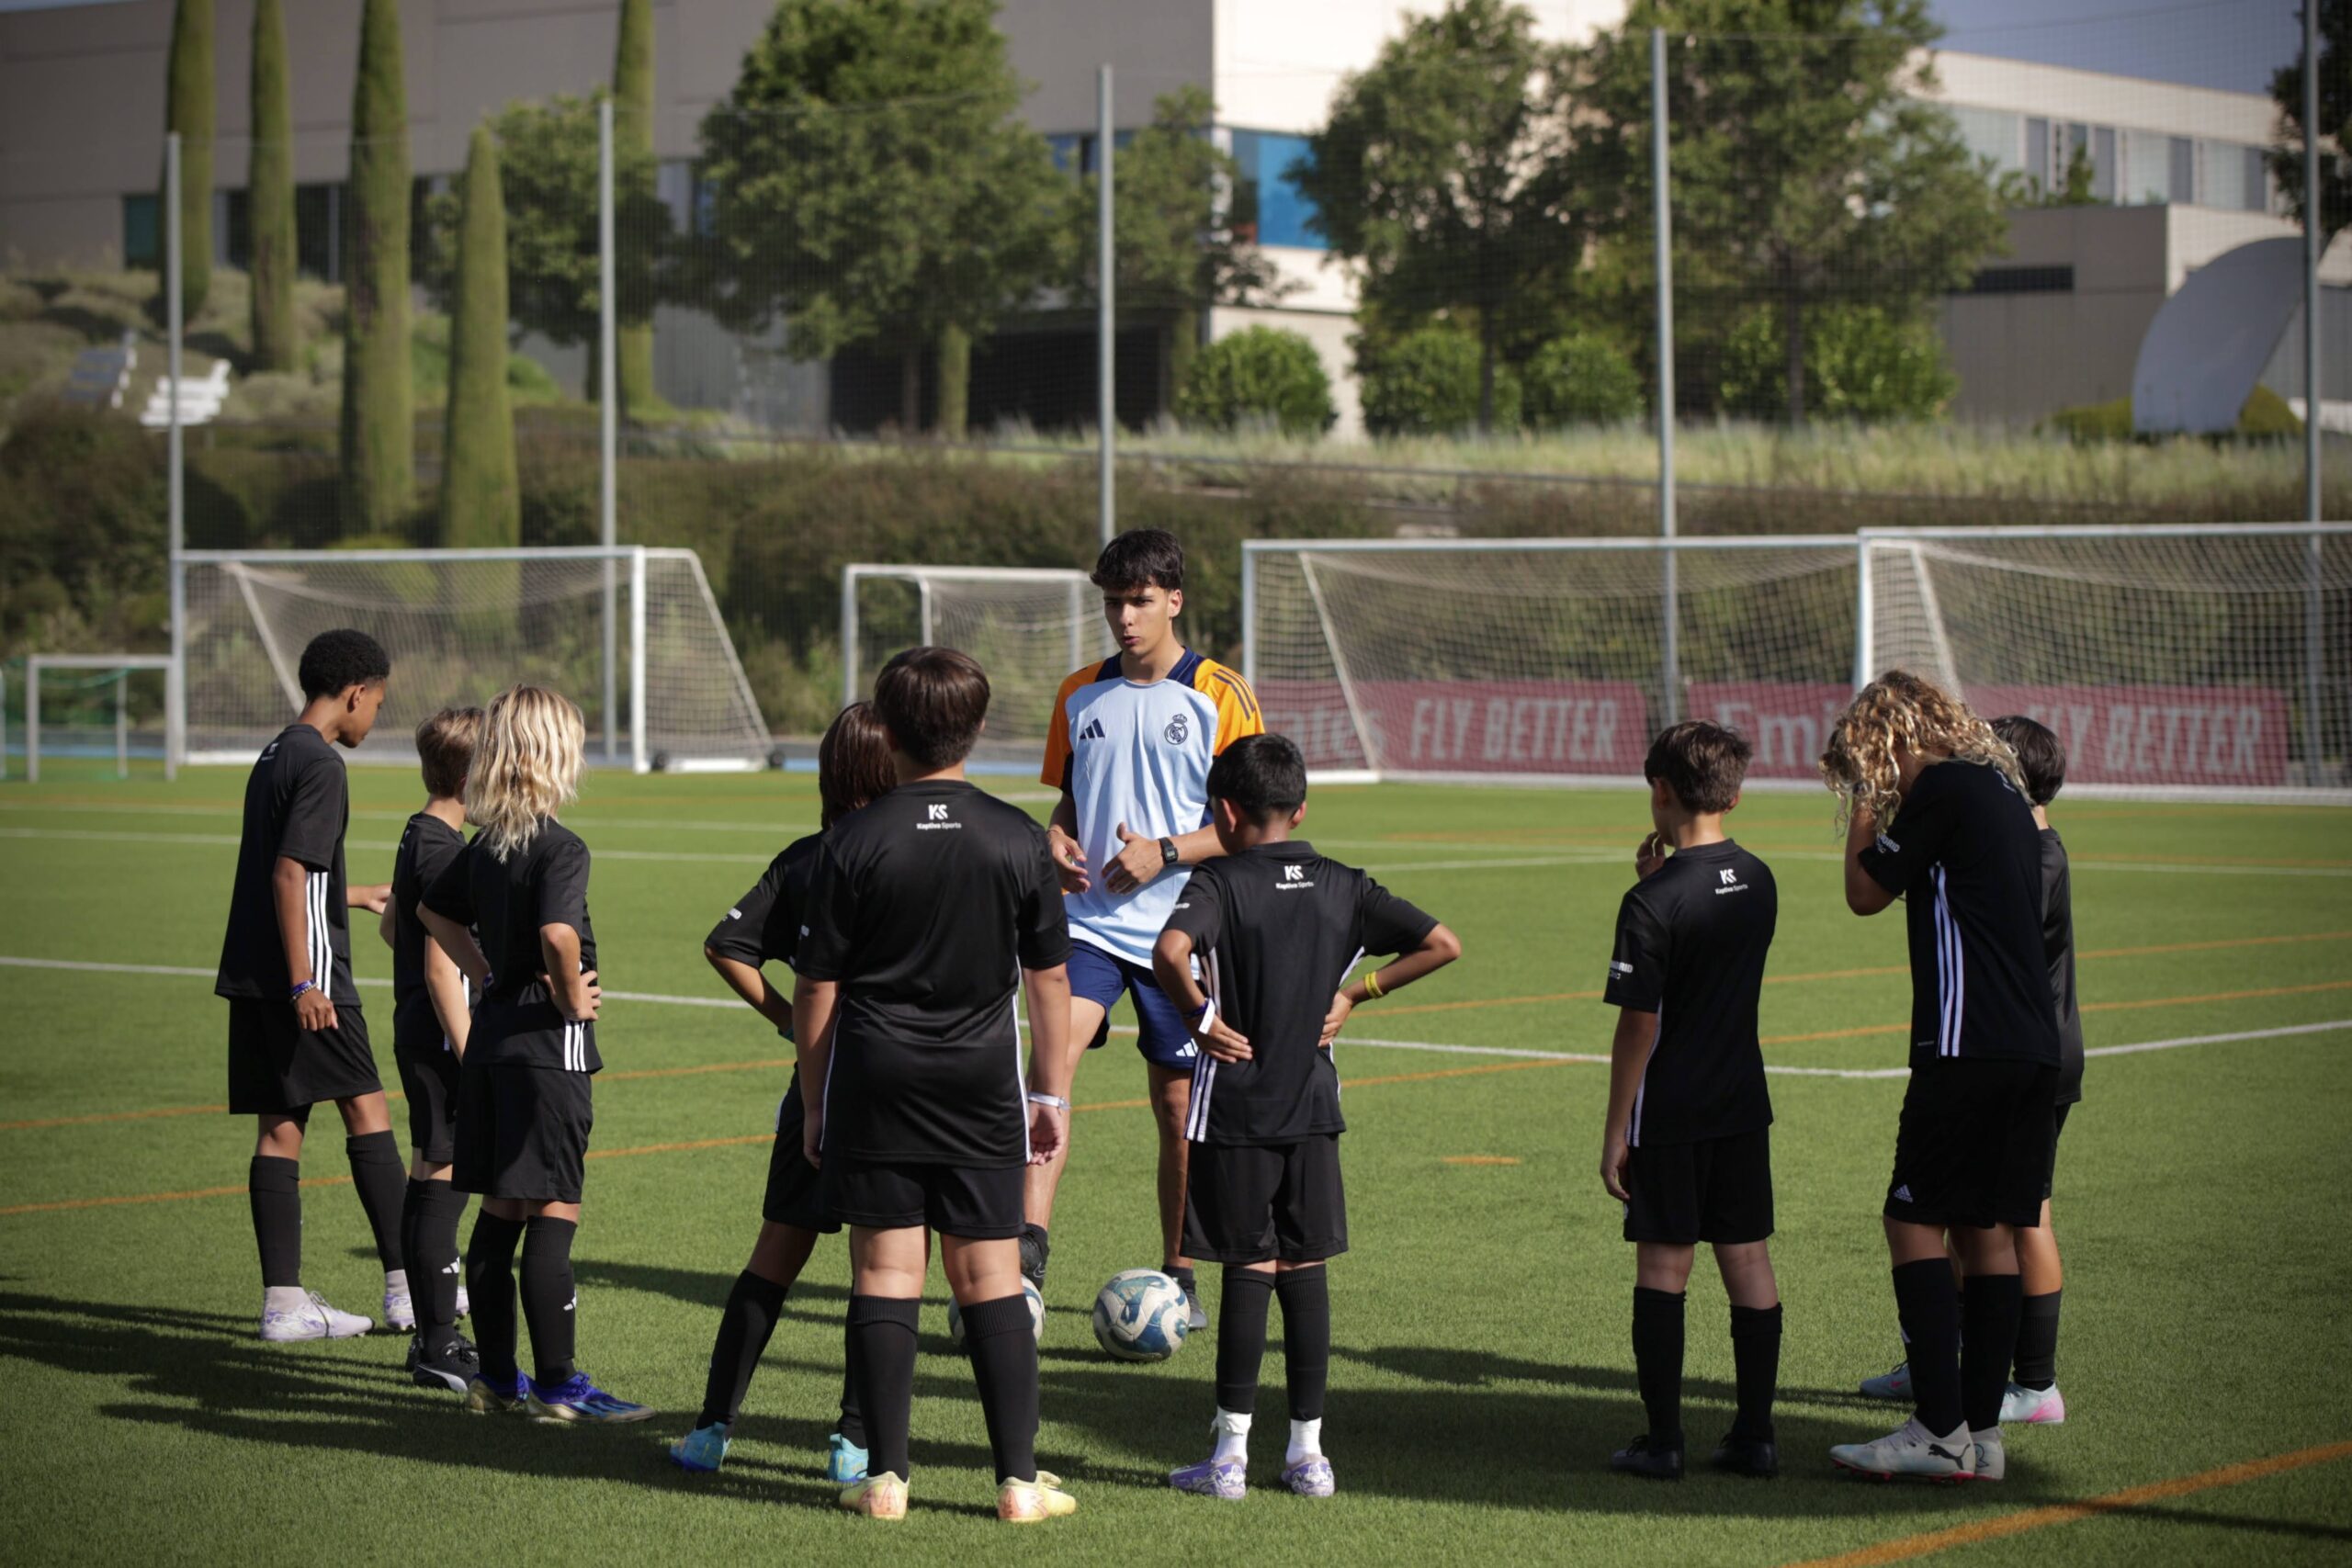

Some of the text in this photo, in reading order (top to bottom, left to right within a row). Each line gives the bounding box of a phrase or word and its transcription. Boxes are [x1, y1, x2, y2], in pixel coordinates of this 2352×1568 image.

[1410, 697, 1618, 762] FLY BETTER
[2104, 704, 2262, 773] BETTER
[916, 821, 962, 830] Kaptiva Sports
